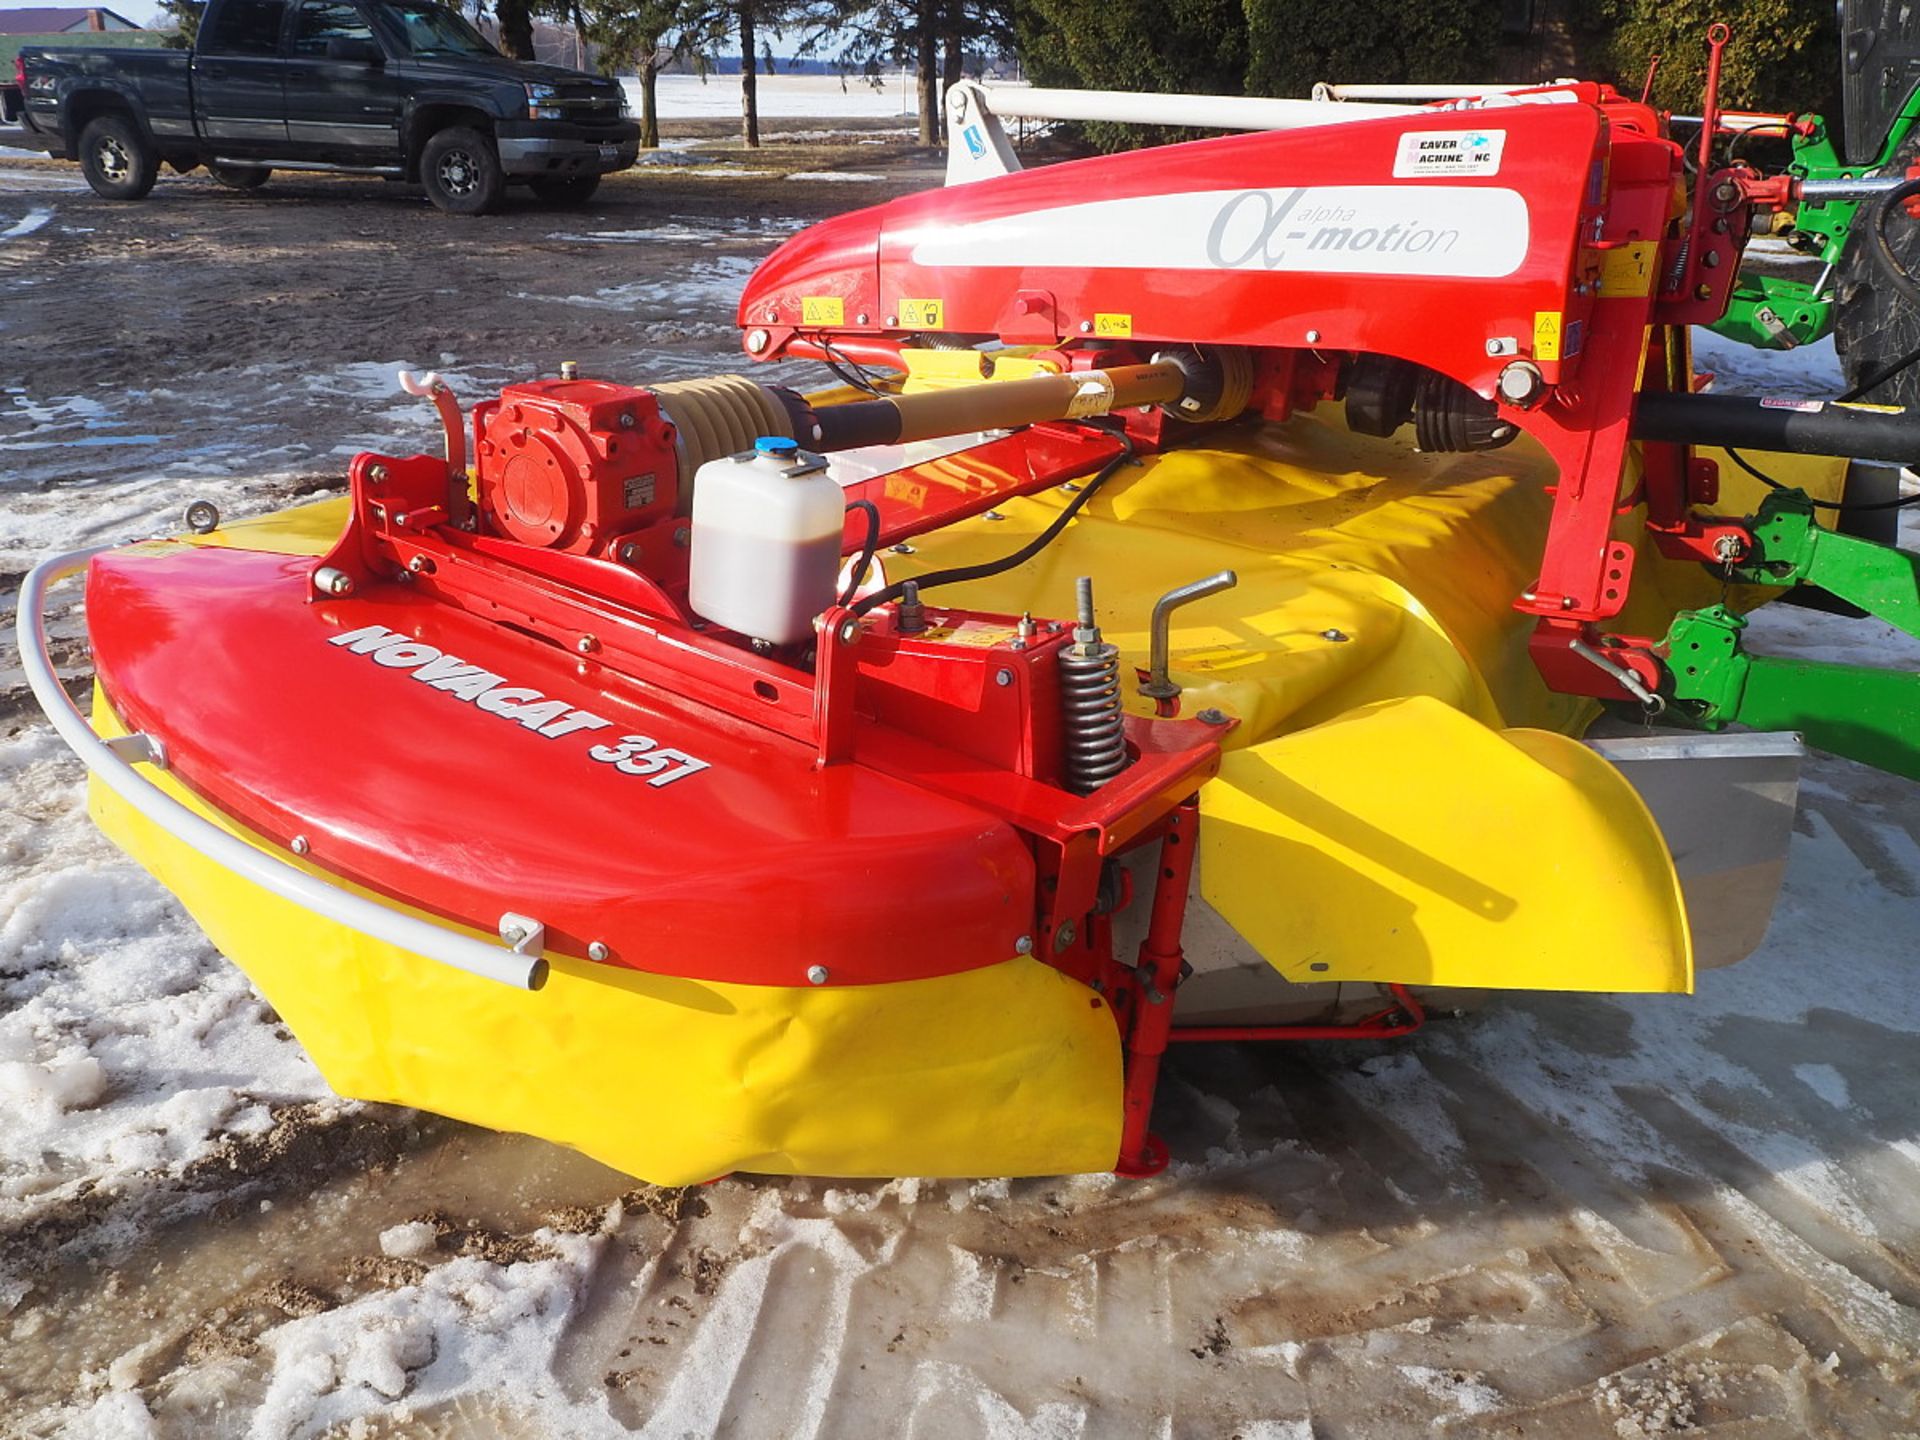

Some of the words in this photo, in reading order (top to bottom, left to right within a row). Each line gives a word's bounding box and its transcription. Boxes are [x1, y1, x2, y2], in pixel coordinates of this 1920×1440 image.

[1297, 206, 1356, 223] alpha
[328, 625, 613, 738] NOVACAT
[588, 735, 711, 787] 357
